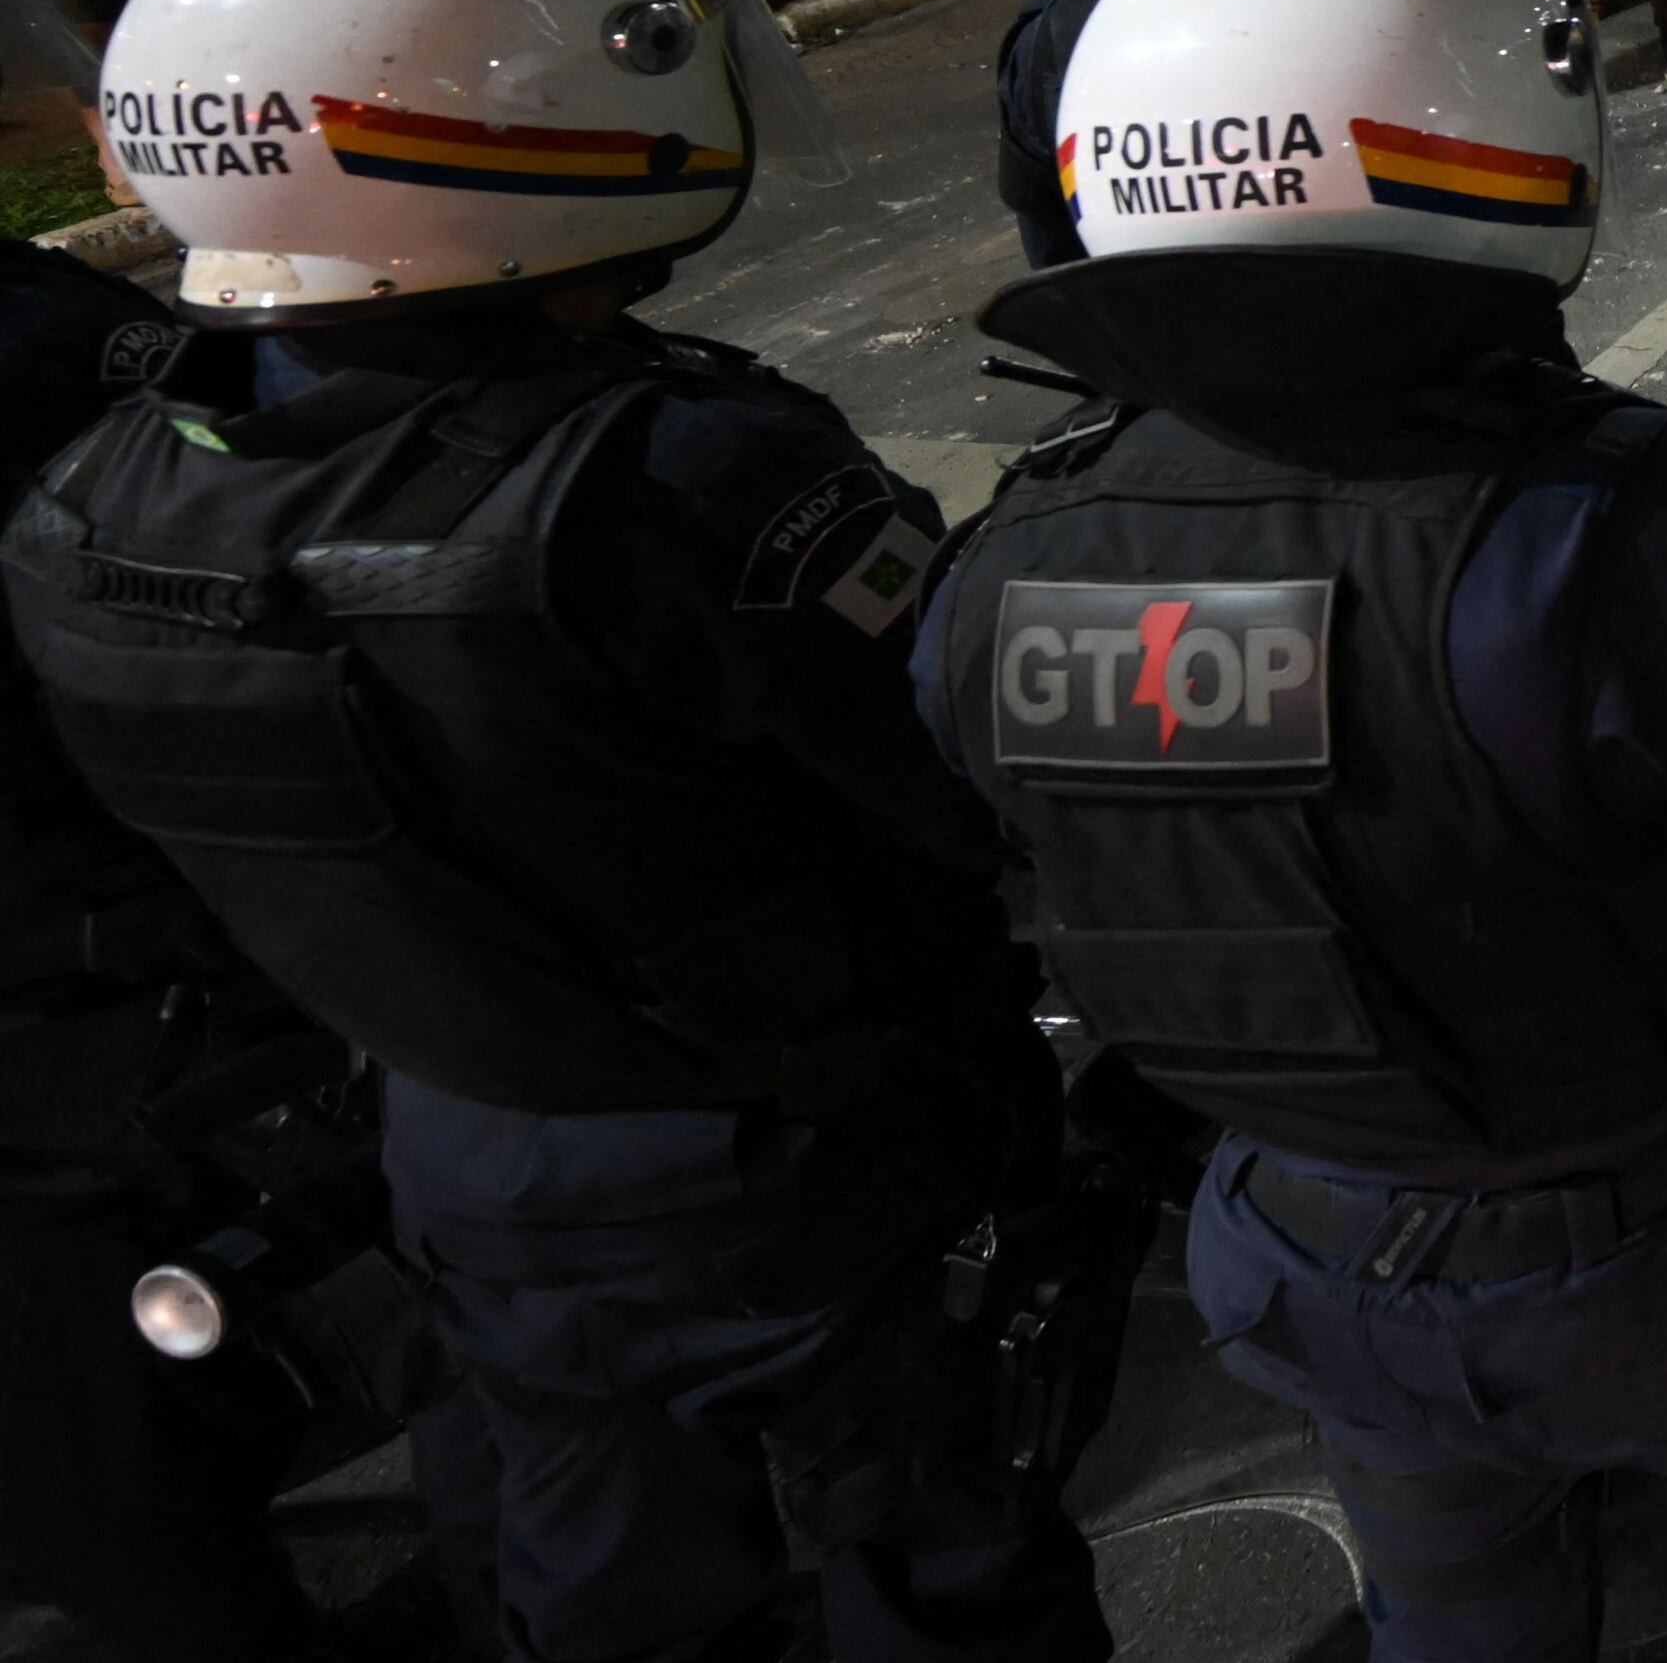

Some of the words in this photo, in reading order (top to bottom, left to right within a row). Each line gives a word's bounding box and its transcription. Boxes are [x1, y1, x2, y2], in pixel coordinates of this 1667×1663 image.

[118, 140, 291, 177] MILITAR
[1110, 167, 1308, 215] MILITAR
[772, 485, 842, 553] PMDF
[1002, 625, 1316, 729] GTOP
